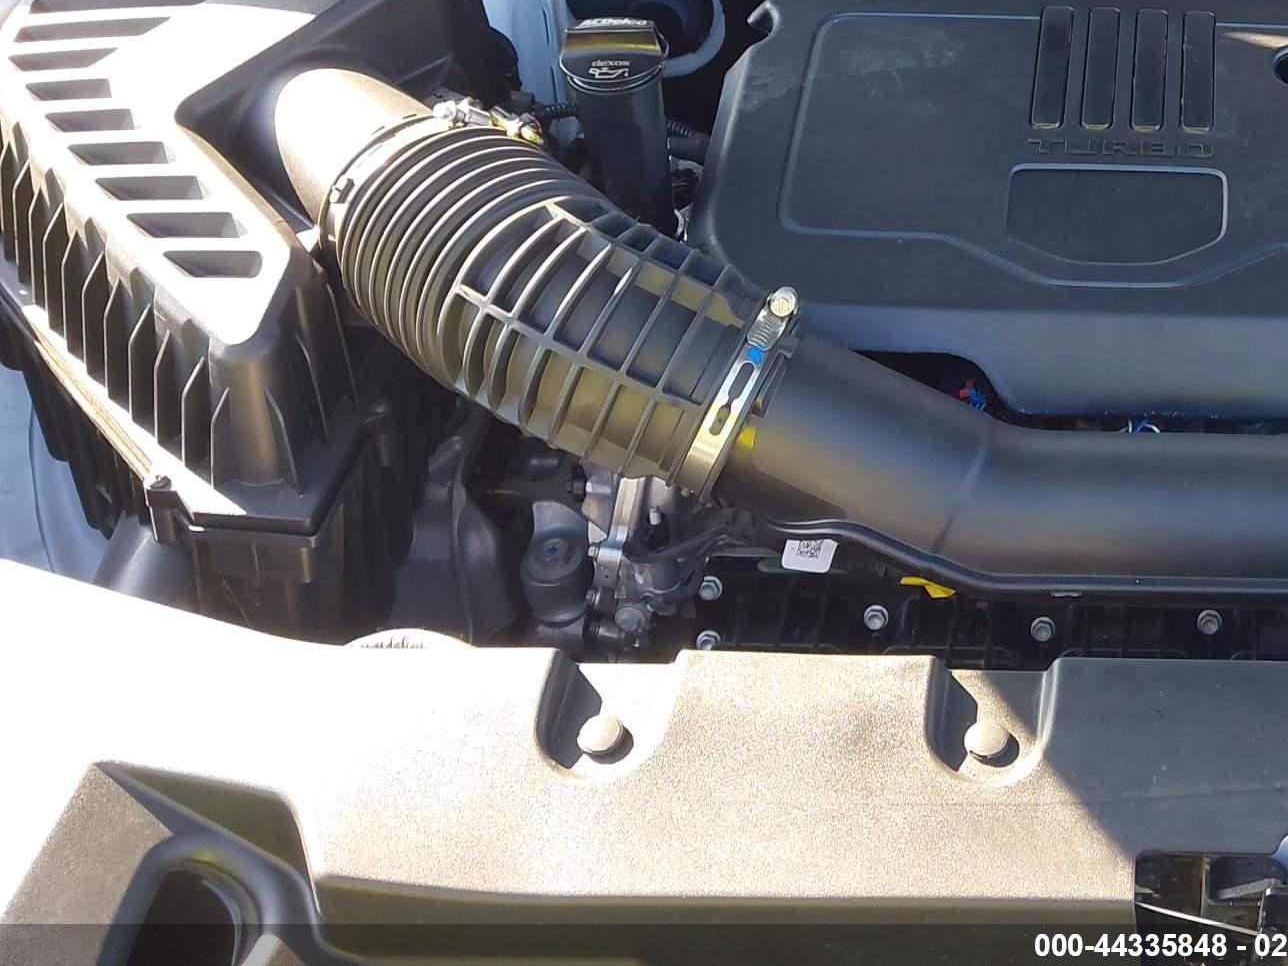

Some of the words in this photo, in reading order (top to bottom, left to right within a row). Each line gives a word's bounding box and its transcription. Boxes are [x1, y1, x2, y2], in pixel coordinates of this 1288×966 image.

[574, 17, 648, 29] ACDelco
[591, 59, 631, 67] dexos
[1027, 137, 1215, 158] TURBO
